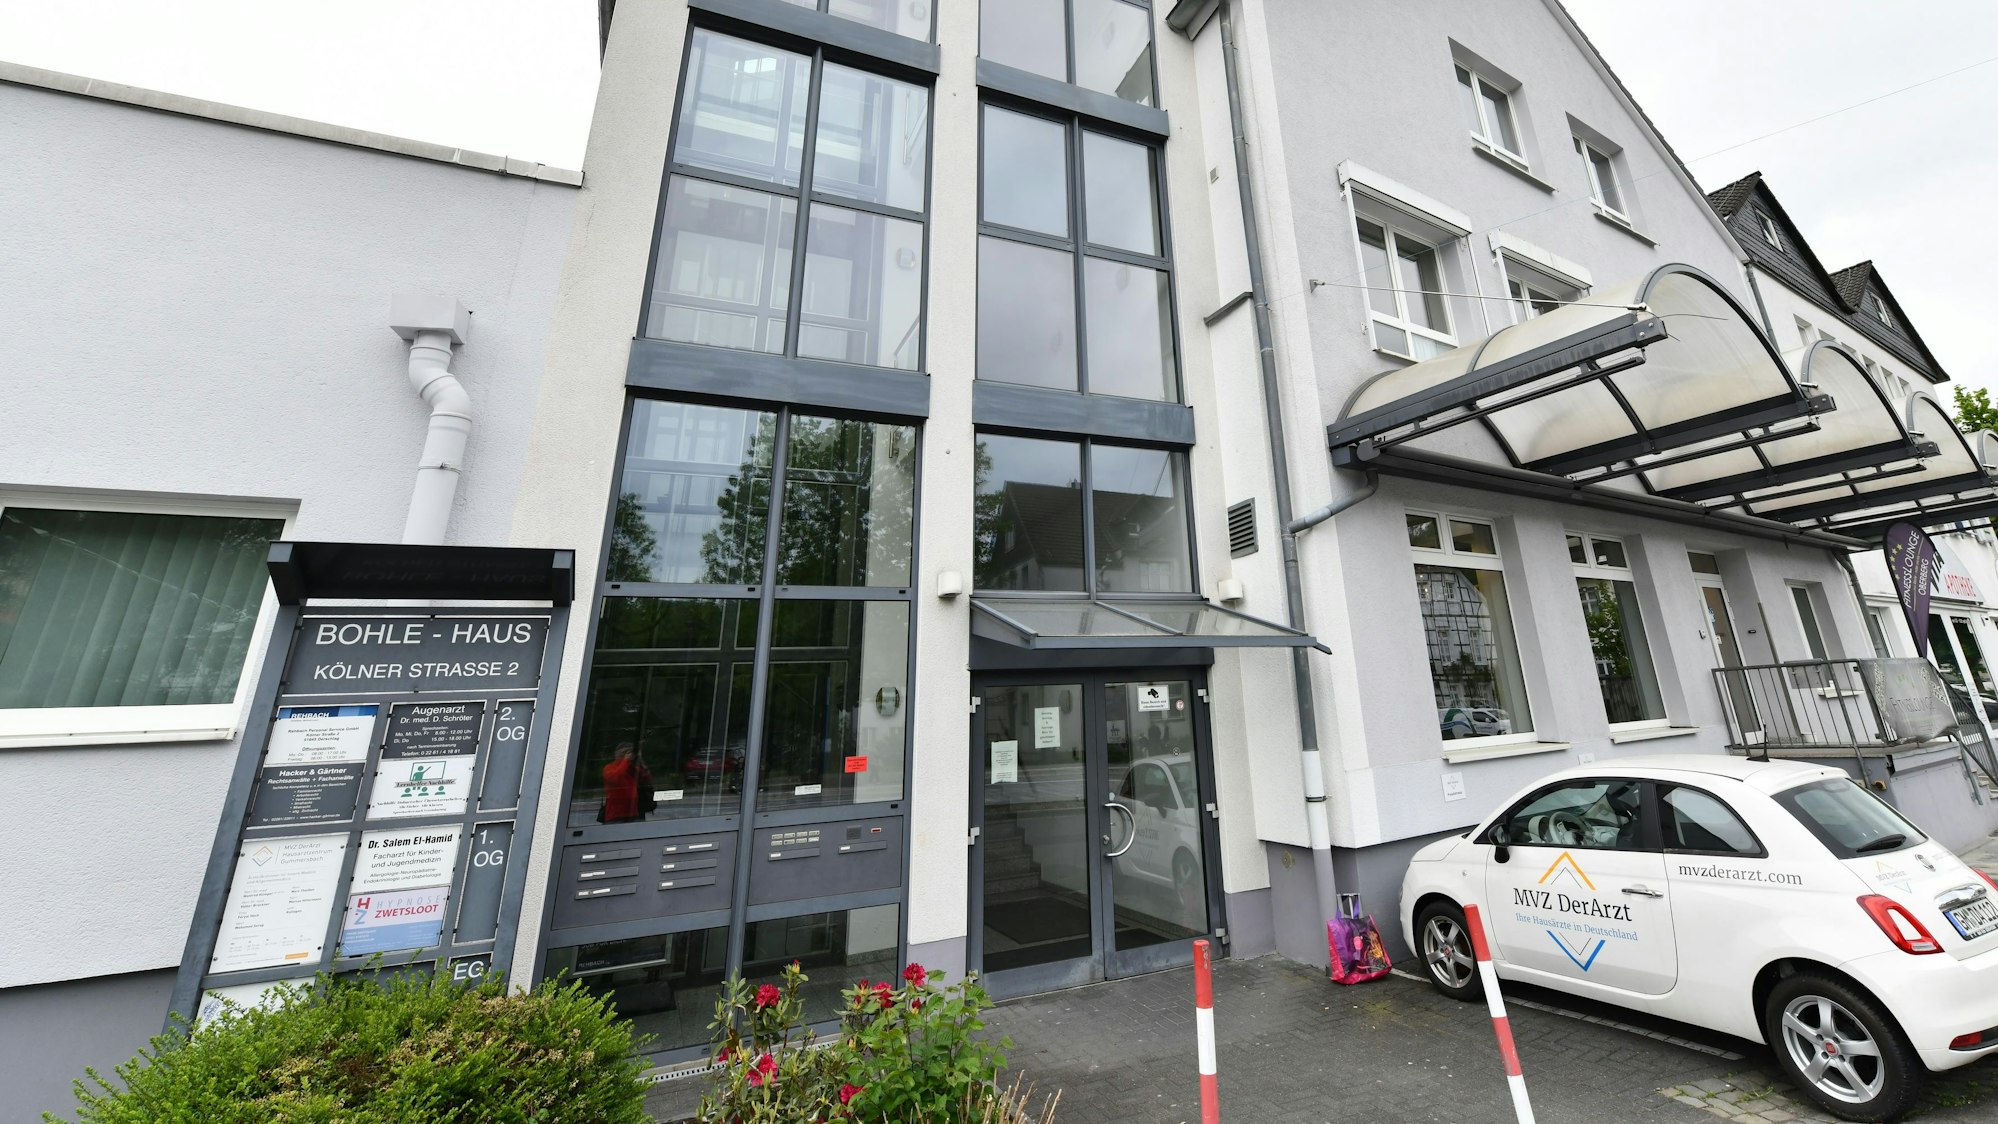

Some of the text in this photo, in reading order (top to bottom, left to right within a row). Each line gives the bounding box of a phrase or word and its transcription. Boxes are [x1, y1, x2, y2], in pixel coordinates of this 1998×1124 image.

[1903, 531, 1920, 609] FITNESSLOUNGE
[1918, 558, 1929, 596] OBERBERG
[315, 624, 424, 645] BOHLE
[451, 623, 532, 644] HAUS
[314, 662, 519, 680] KÖLNER STRASSE 2
[412, 705, 466, 716] Augenarzt
[500, 707, 516, 720] 2.
[497, 726, 525, 741] OG
[368, 834, 453, 849] Dr. Salem El-Hamid
[480, 830, 494, 844] 1.
[388, 856, 442, 868] Jugendmedizin
[474, 850, 504, 867] OG
[1678, 863, 1803, 886] mvzderarzt.com
[377, 894, 440, 909] HYPNOSE
[1513, 887, 1633, 922] MVZ DerArzt
[375, 904, 438, 918] ZWETSLOOT
[1514, 912, 1638, 942] Ihre Hausärzte in Deutschland
[454, 961, 485, 980] EG
